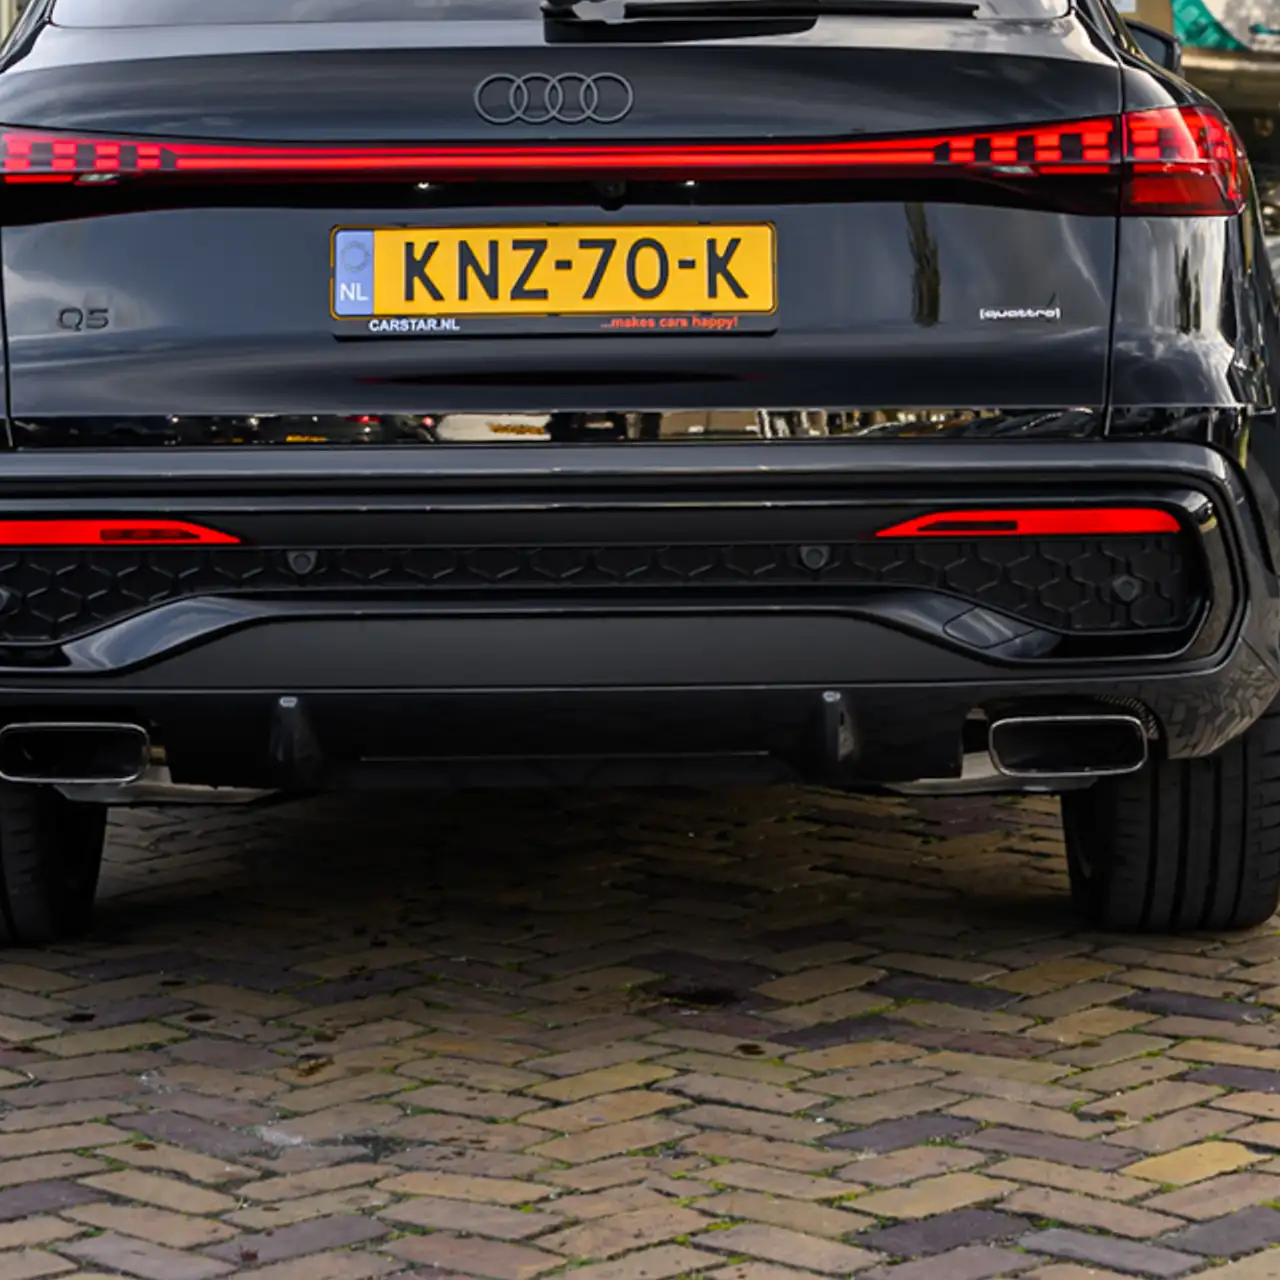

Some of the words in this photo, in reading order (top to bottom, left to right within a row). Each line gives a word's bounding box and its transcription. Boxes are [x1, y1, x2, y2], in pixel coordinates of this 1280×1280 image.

[404, 237, 748, 302] KNZ-70-K
[339, 282, 369, 301] NL
[59, 307, 109, 332] Q5
[368, 319, 460, 332] CARSTAR.NL
[659, 318, 688, 328] cars
[691, 315, 738, 330] happy!
